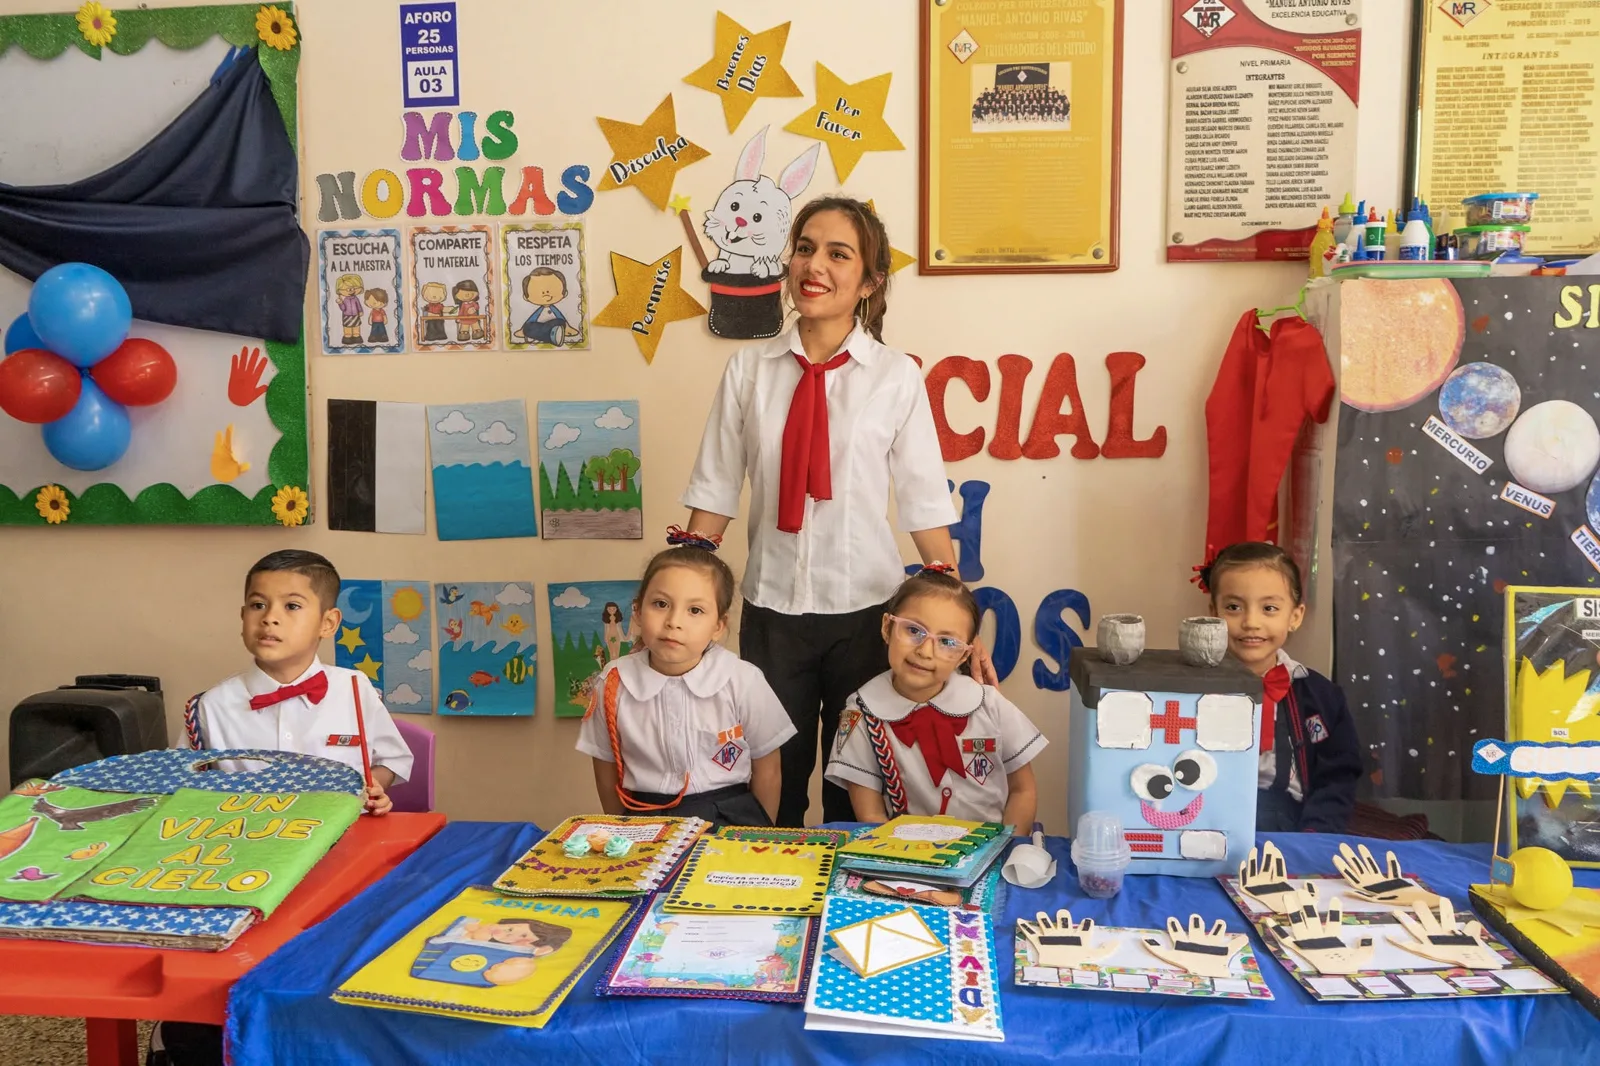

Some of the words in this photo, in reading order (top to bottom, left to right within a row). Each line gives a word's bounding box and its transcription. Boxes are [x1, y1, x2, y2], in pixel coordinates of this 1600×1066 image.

[404, 11, 452, 24] AFORO
[1005, 12, 1050, 25] ANTONIO
[1272, 10, 1310, 18] EXCELENCIA
[417, 29, 440, 44] 25
[405, 45, 454, 55] PERSONAS
[1482, 50, 1560, 60] INTEGRANTES
[716, 34, 750, 91] Buenos
[1240, 60, 1258, 68] NIVEL
[414, 66, 447, 77] AULA
[419, 78, 443, 94] 03
[835, 96, 862, 118] Por
[816, 111, 862, 141] Favor
[400, 110, 518, 162] MIS
[609, 136, 688, 184] Disculpa
[316, 164, 595, 223] NORMAS
[333, 242, 390, 256] ESCUCHA
[418, 237, 482, 251] COMPARTE
[517, 236, 572, 250] RESPETA
[330, 262, 337, 272] A
[340, 261, 351, 272] LA
[353, 260, 392, 272] MAESTRA
[423, 257, 436, 268] TU
[437, 255, 480, 268] MATERIAL
[514, 255, 532, 267] LOS
[534, 253, 574, 266] TIEMPOS
[632, 258, 672, 336] Permiso
[905, 351, 1168, 463] CIAL
[1424, 419, 1488, 472] MERCURIO
[1504, 486, 1552, 516] VENUS
[1584, 600, 1600, 616] SI
[218, 794, 299, 813] UN
[160, 816, 322, 840] VIAJE
[161, 844, 234, 866] AL
[90, 866, 272, 892] CIELO
[482, 897, 601, 918] ADIVINA
